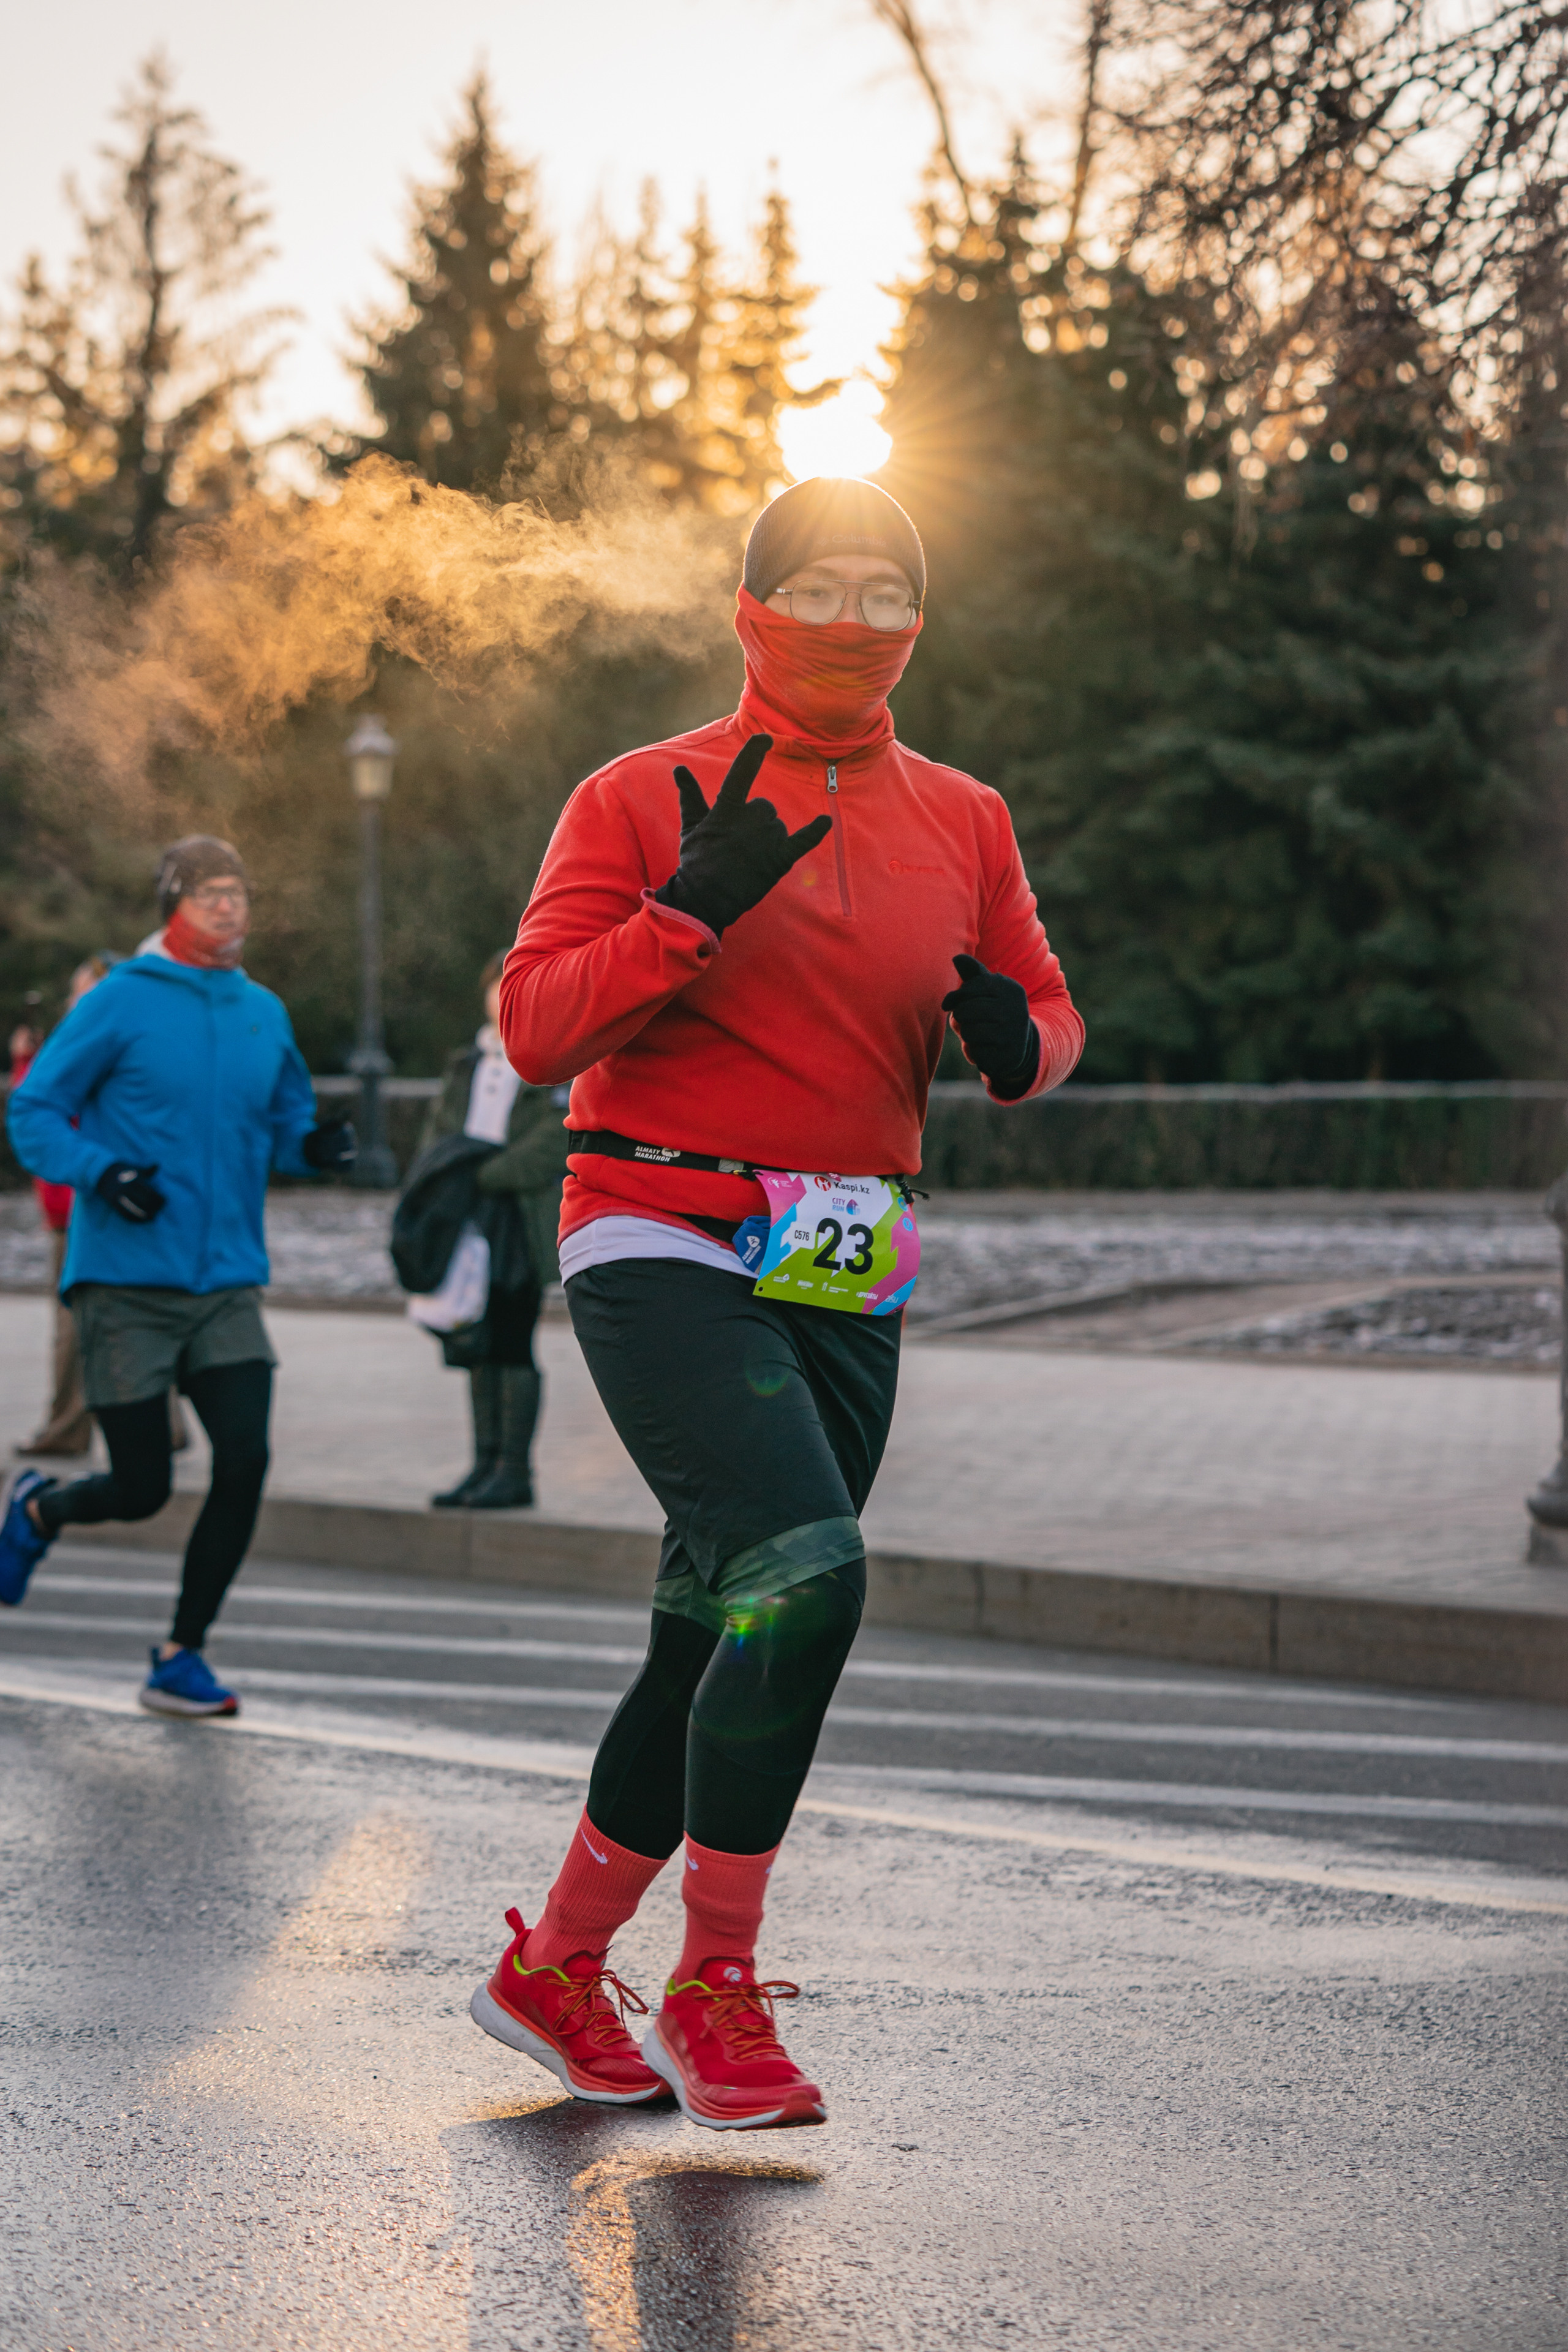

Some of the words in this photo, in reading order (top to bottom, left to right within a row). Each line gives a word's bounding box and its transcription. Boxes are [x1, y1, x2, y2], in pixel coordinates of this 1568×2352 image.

[832, 533, 887, 547] Columbia
[635, 1146, 661, 1155] ALMATY
[635, 1152, 671, 1162] MARATHON
[834, 1182, 870, 1194] Kaspi.kz
[832, 1197, 846, 1206] CITY
[794, 1229, 810, 1242] C576
[812, 1218, 874, 1275] 23
